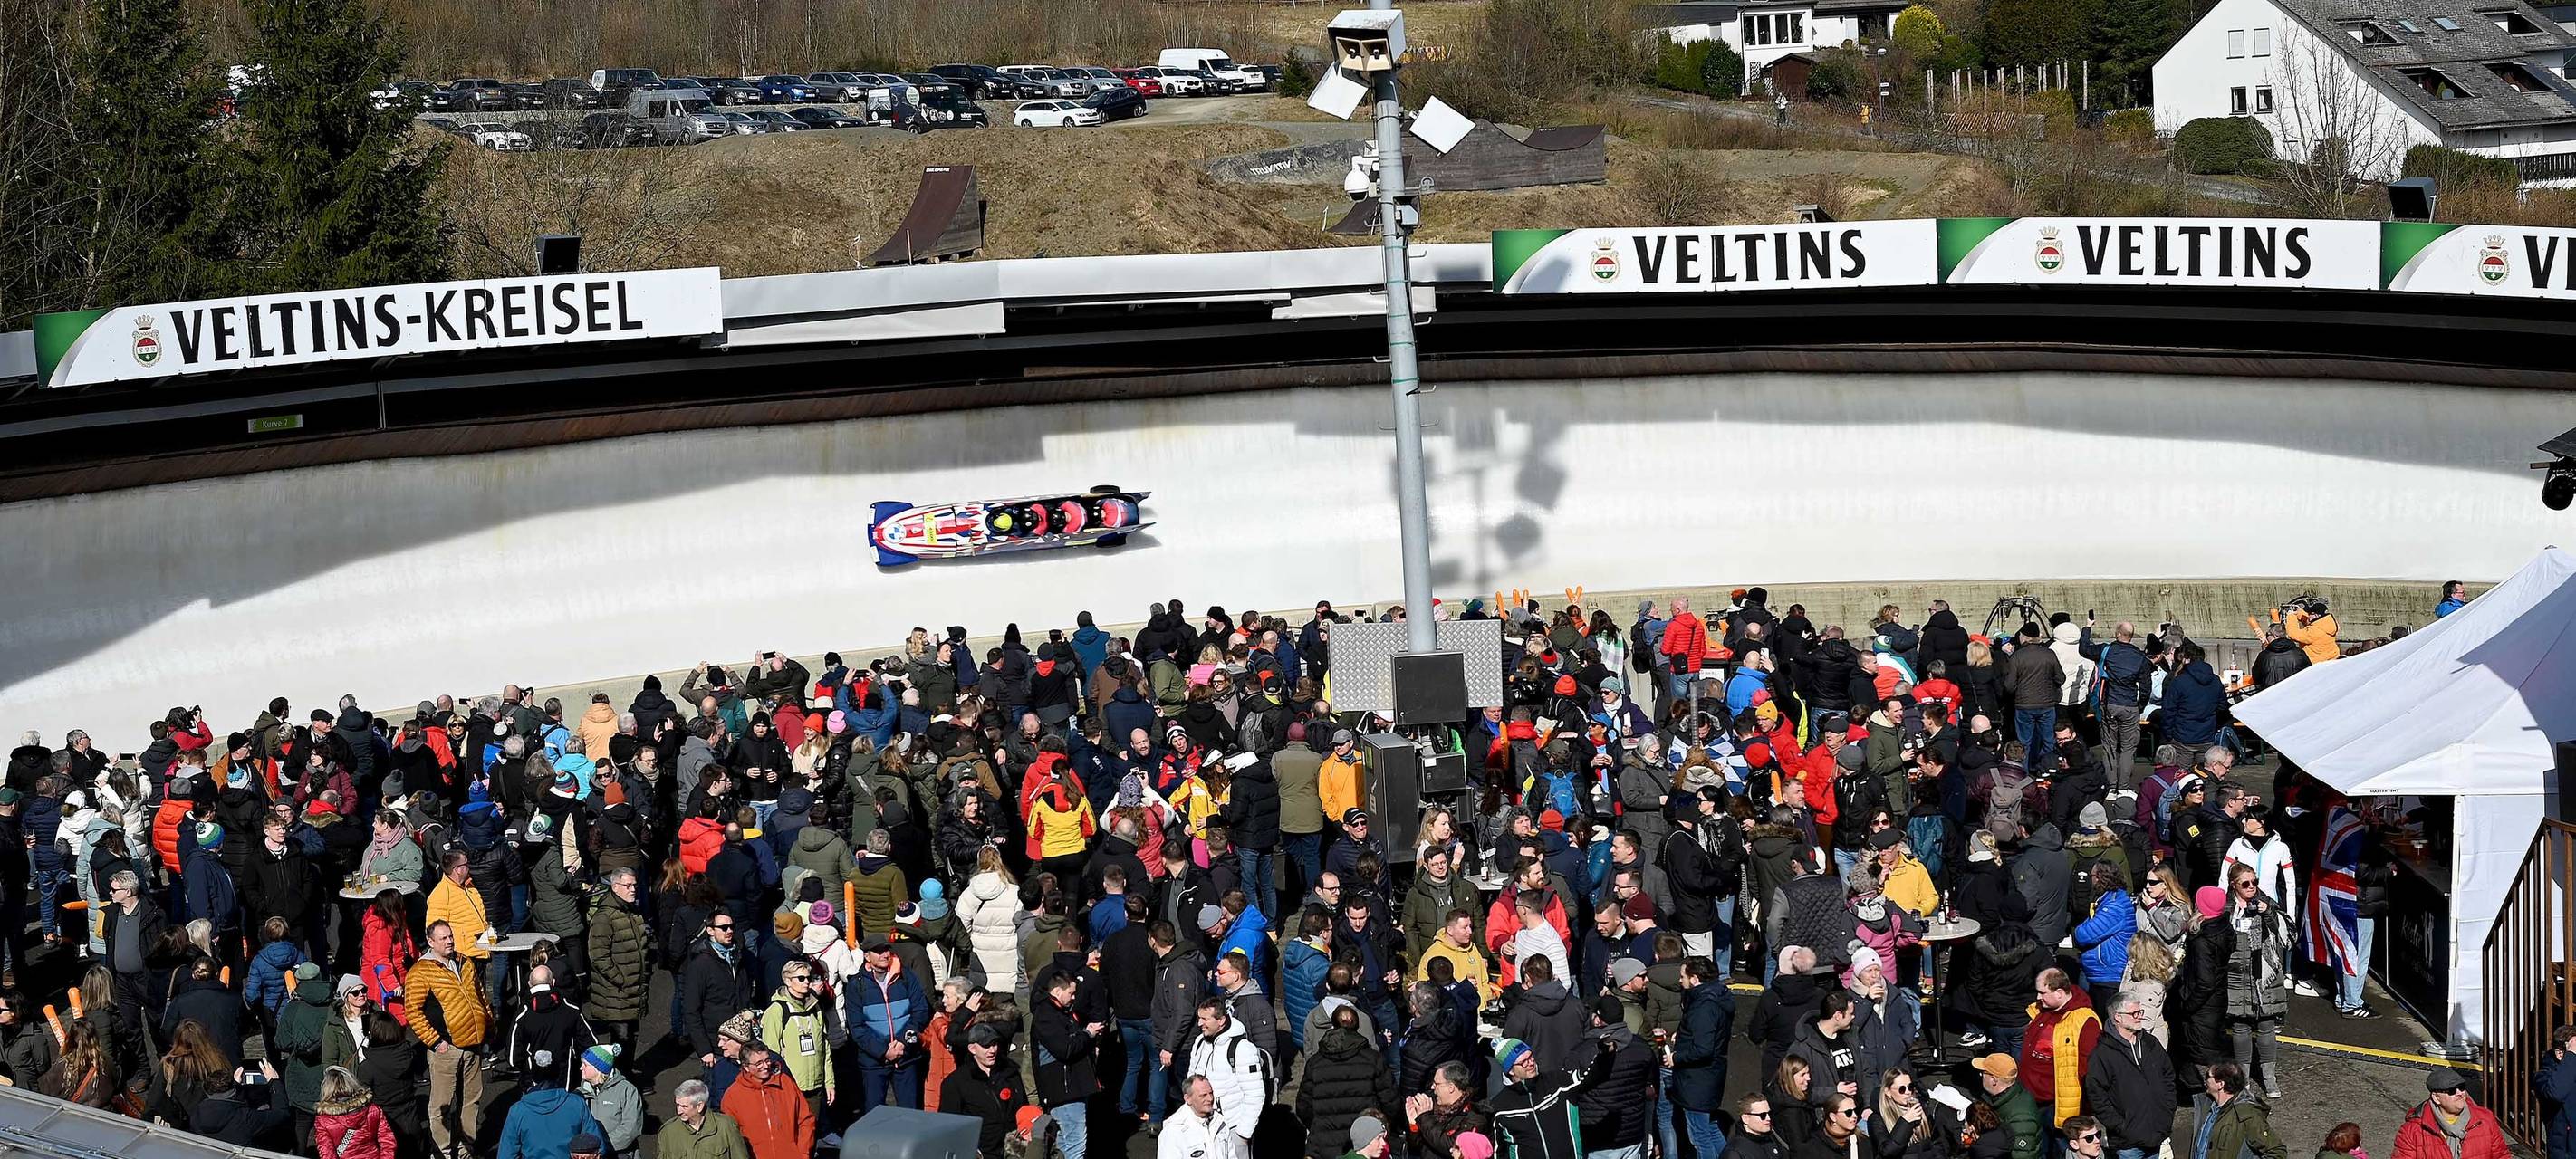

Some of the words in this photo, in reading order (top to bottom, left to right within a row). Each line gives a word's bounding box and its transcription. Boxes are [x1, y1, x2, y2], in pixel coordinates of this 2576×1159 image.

[1632, 230, 1866, 284] VELTINS
[2077, 226, 2312, 280] VELTINS
[169, 280, 643, 365] VELTINS-KREISEL
[262, 420, 283, 428] Kurve
